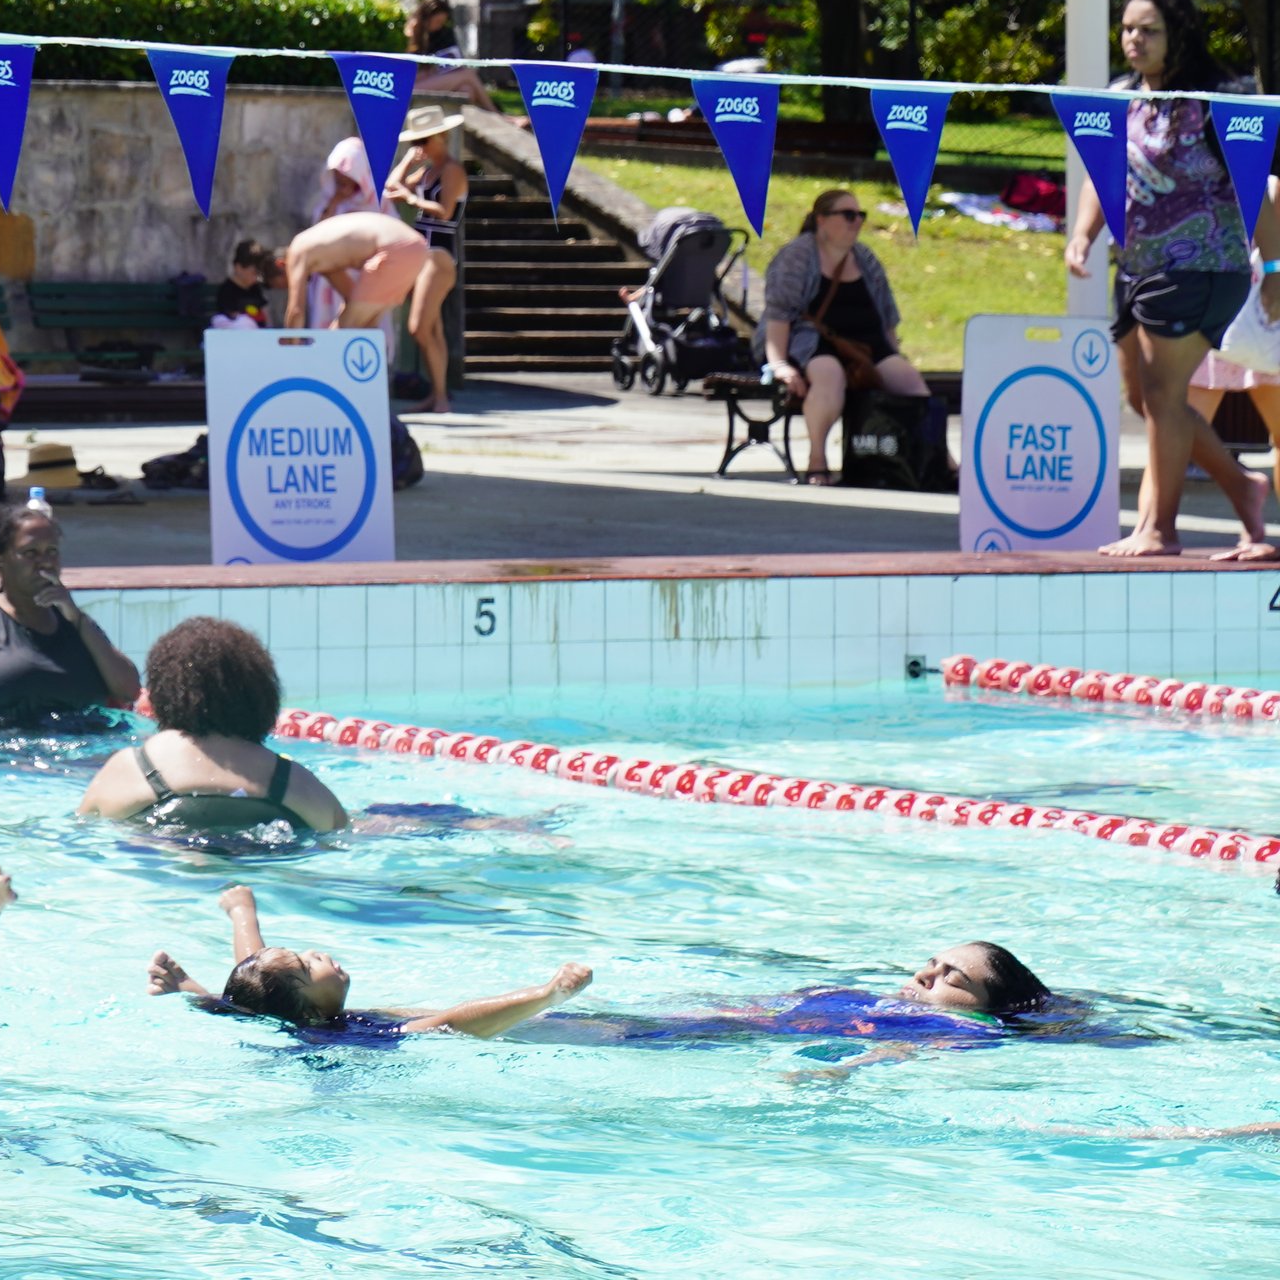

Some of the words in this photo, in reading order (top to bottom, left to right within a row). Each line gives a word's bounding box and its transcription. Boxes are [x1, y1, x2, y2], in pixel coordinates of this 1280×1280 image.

[170, 70, 209, 89] ZOGGS
[353, 70, 394, 91] ZOGGS
[533, 81, 574, 101] ZOGGS
[716, 97, 759, 115] ZOGGS
[887, 105, 927, 123] ZOGGS
[1074, 112, 1111, 130] ZOGGS
[1227, 116, 1263, 132] ZOGGS
[248, 428, 352, 456] MEDIUM
[1009, 425, 1072, 450] FAST
[1006, 455, 1072, 481] LANE
[268, 465, 336, 493] LANE
[474, 597, 496, 636] 5
